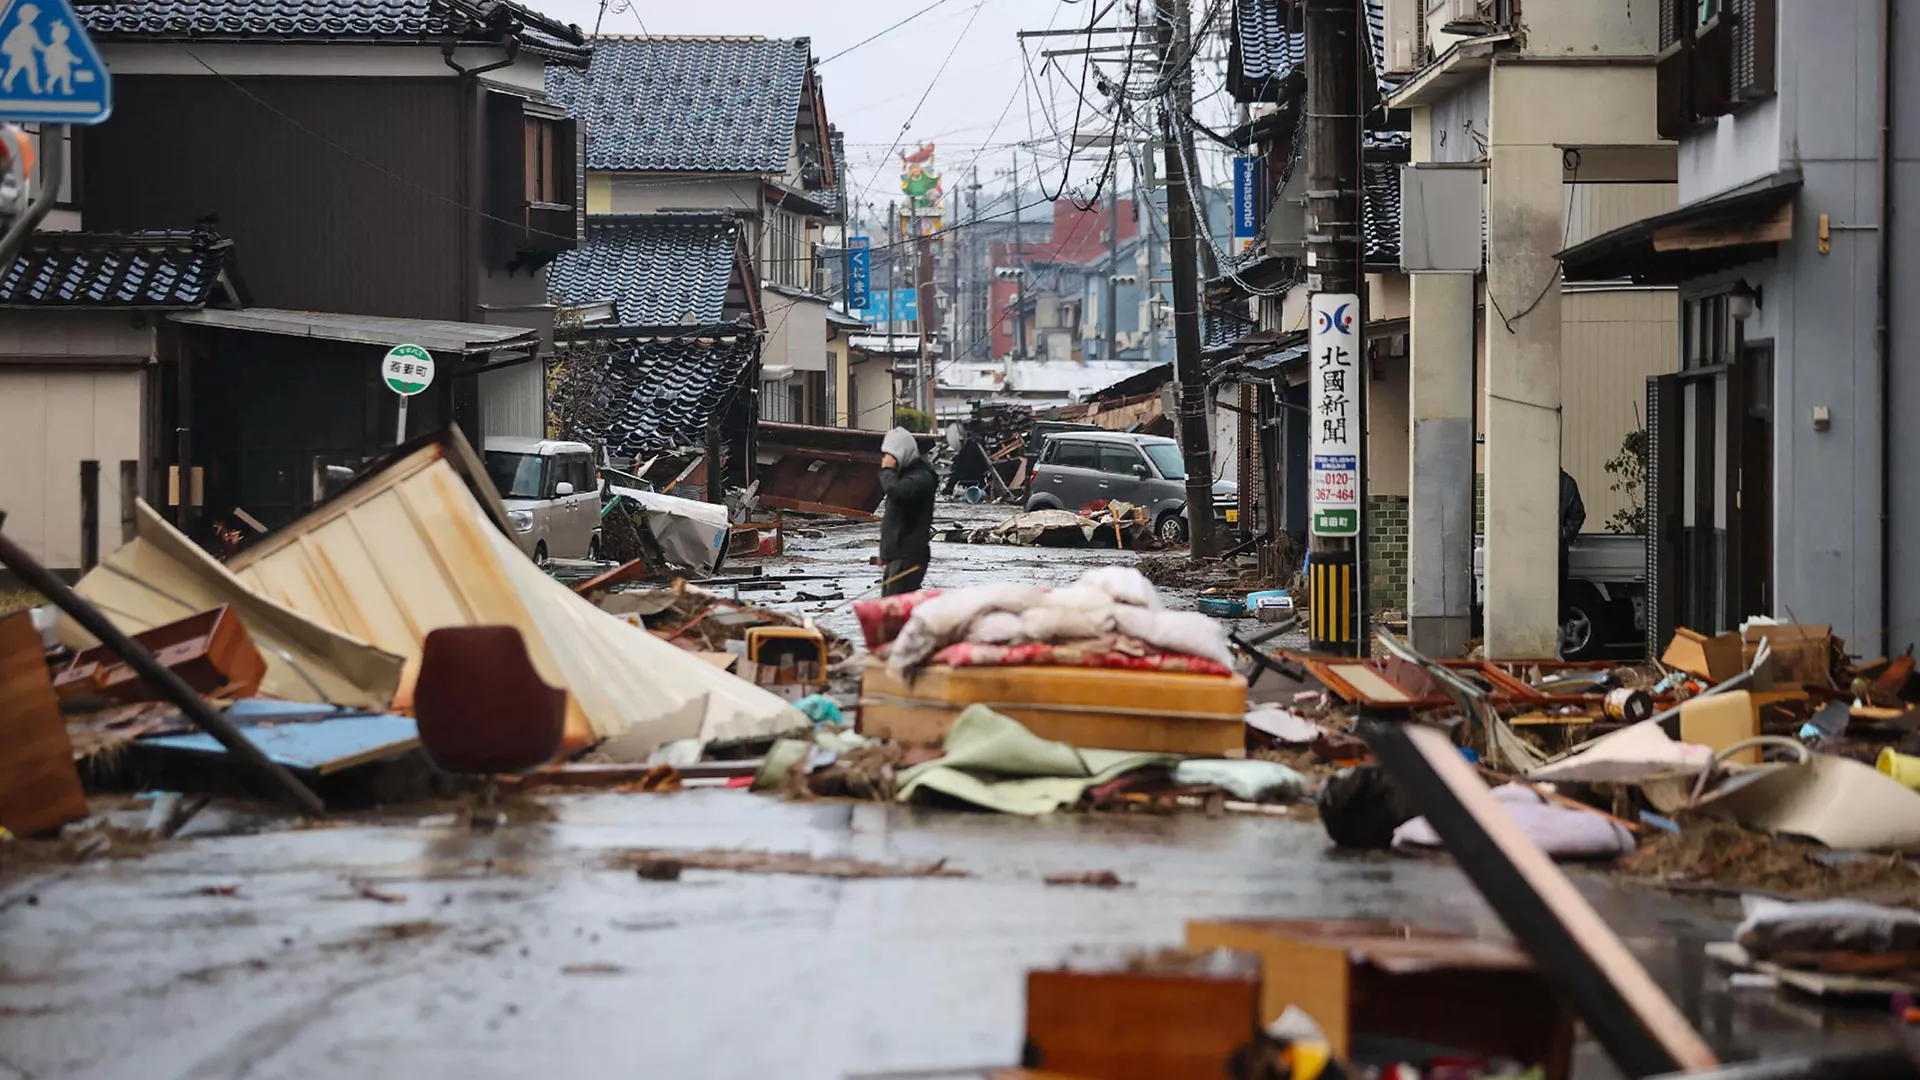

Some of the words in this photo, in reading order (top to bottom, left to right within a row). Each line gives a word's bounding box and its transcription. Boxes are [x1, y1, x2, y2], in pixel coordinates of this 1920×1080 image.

[1243, 162, 1254, 228] Panasonic
[853, 252, 866, 307] くにまつ
[1317, 345, 1352, 444] 北國新聞
[1315, 488, 1354, 501] 367-464
